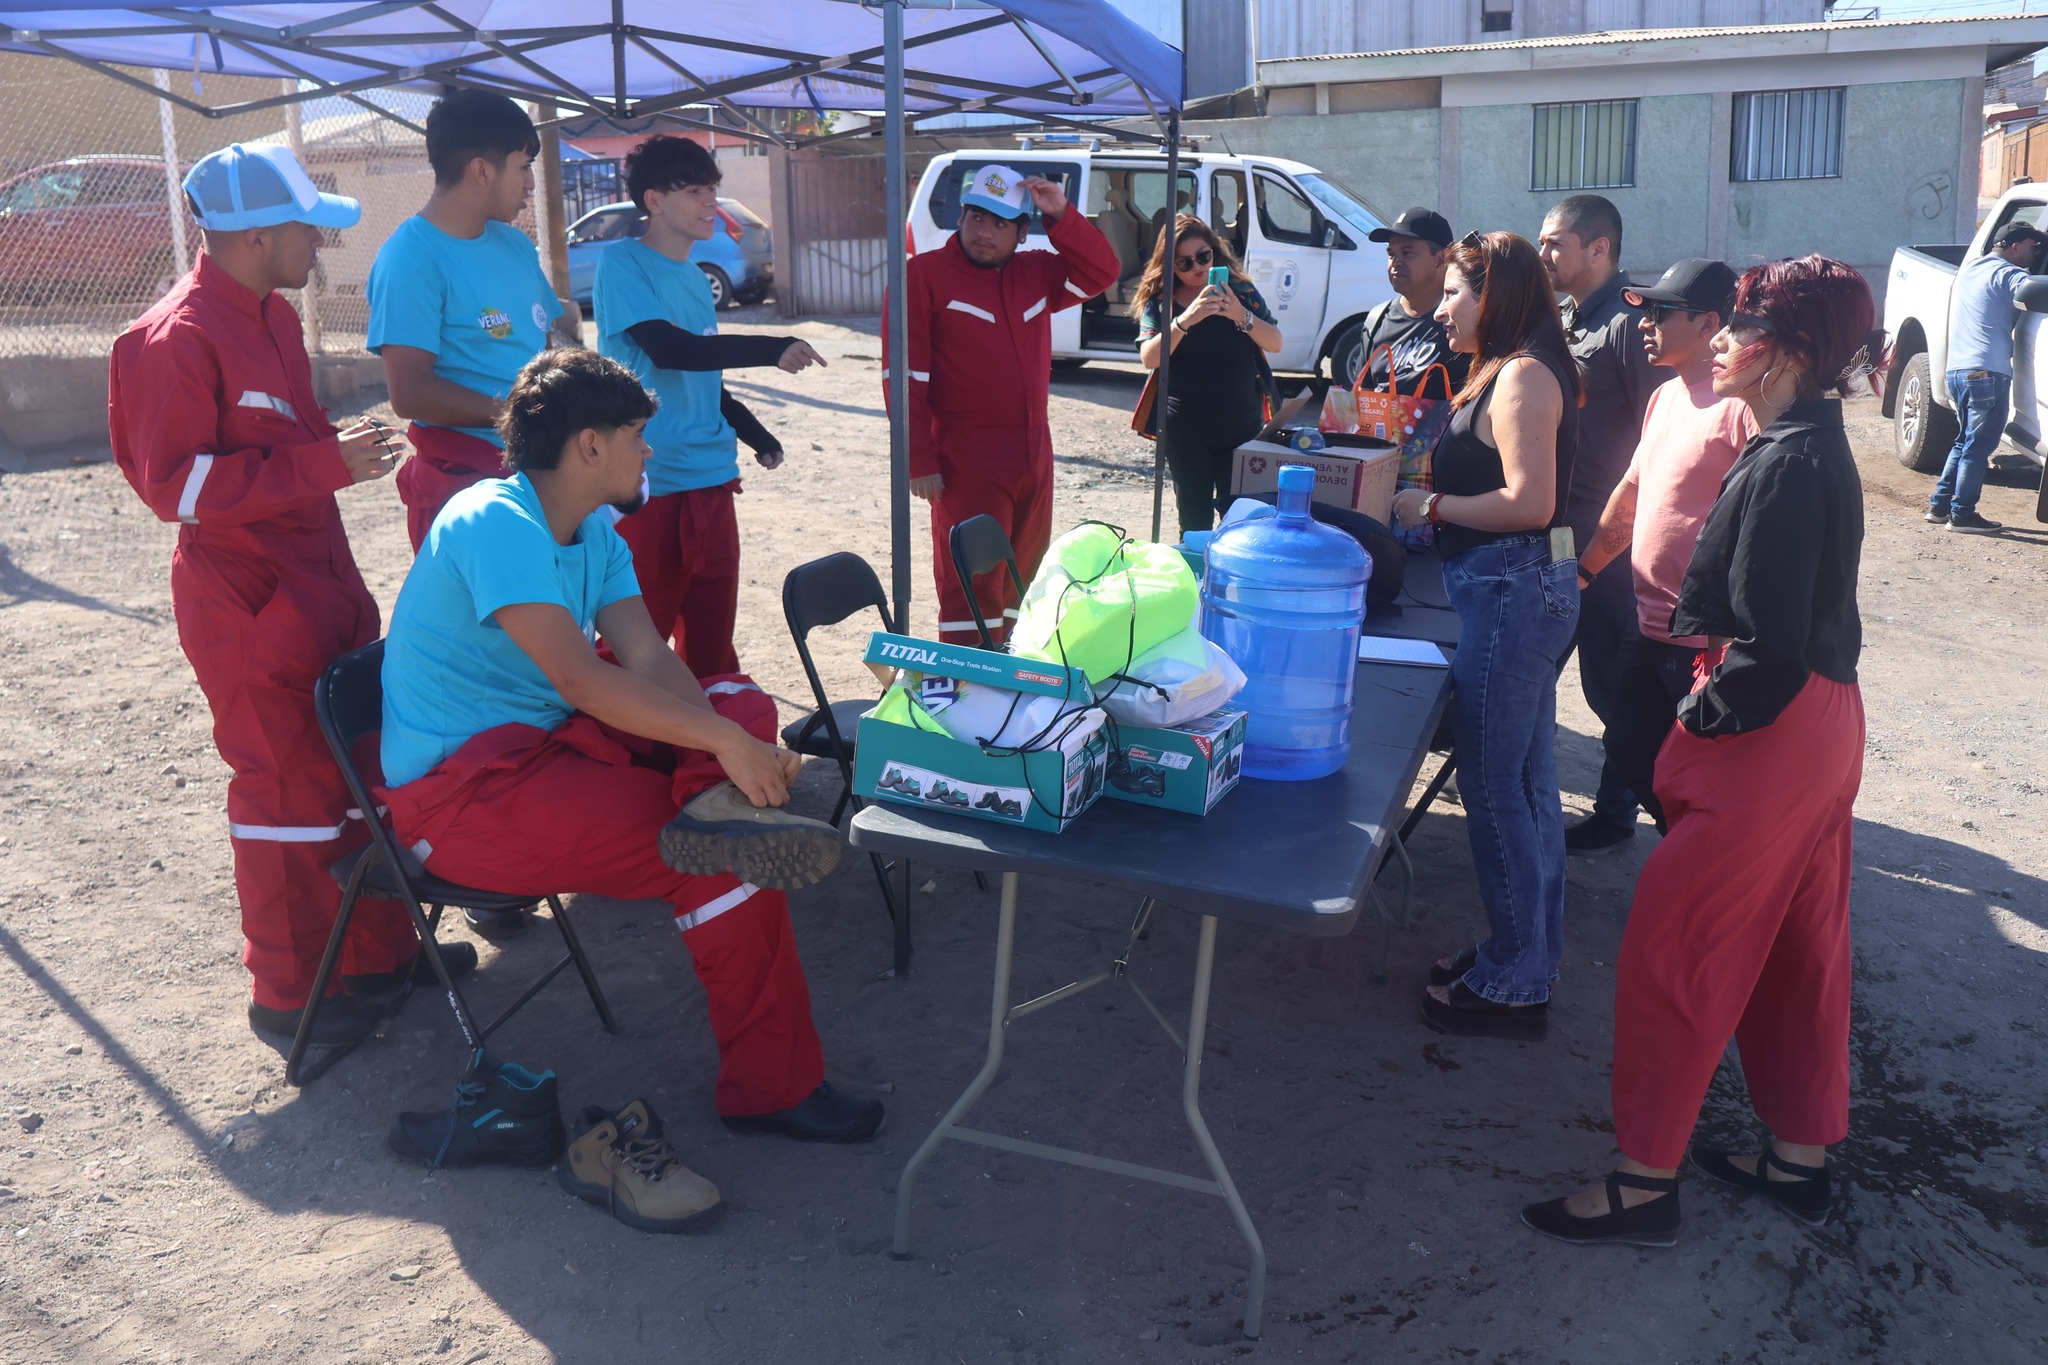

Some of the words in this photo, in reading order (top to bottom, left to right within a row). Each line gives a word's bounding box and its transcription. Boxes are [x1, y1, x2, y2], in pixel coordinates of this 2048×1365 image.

[1336, 465, 1349, 474] AL
[1316, 475, 1348, 486] DEVOL
[880, 642, 938, 666] TOTAL
[940, 656, 966, 668] One-Stop
[966, 661, 981, 669] Tools
[981, 664, 1002, 673] Station
[1018, 671, 1039, 681] SAFETY
[1039, 675, 1058, 684] BOOTS
[1195, 738, 1210, 757] TOTAL
